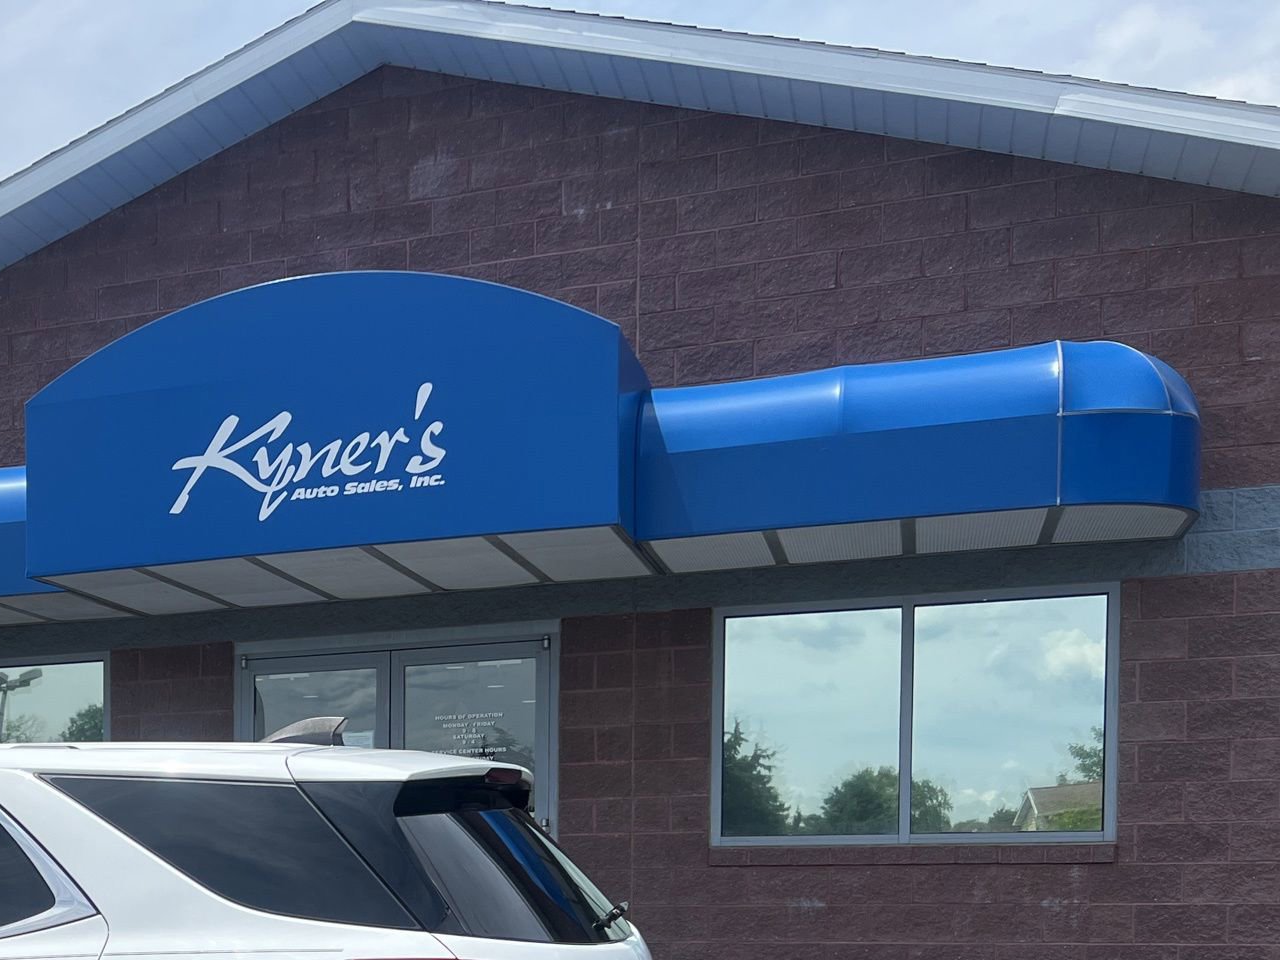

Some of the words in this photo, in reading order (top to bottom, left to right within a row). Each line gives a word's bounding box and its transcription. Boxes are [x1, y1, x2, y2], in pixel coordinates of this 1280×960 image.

[169, 382, 446, 522] Kyner's
[290, 485, 339, 501] Auto
[343, 478, 404, 495] Sales,
[410, 474, 445, 488] Inc.
